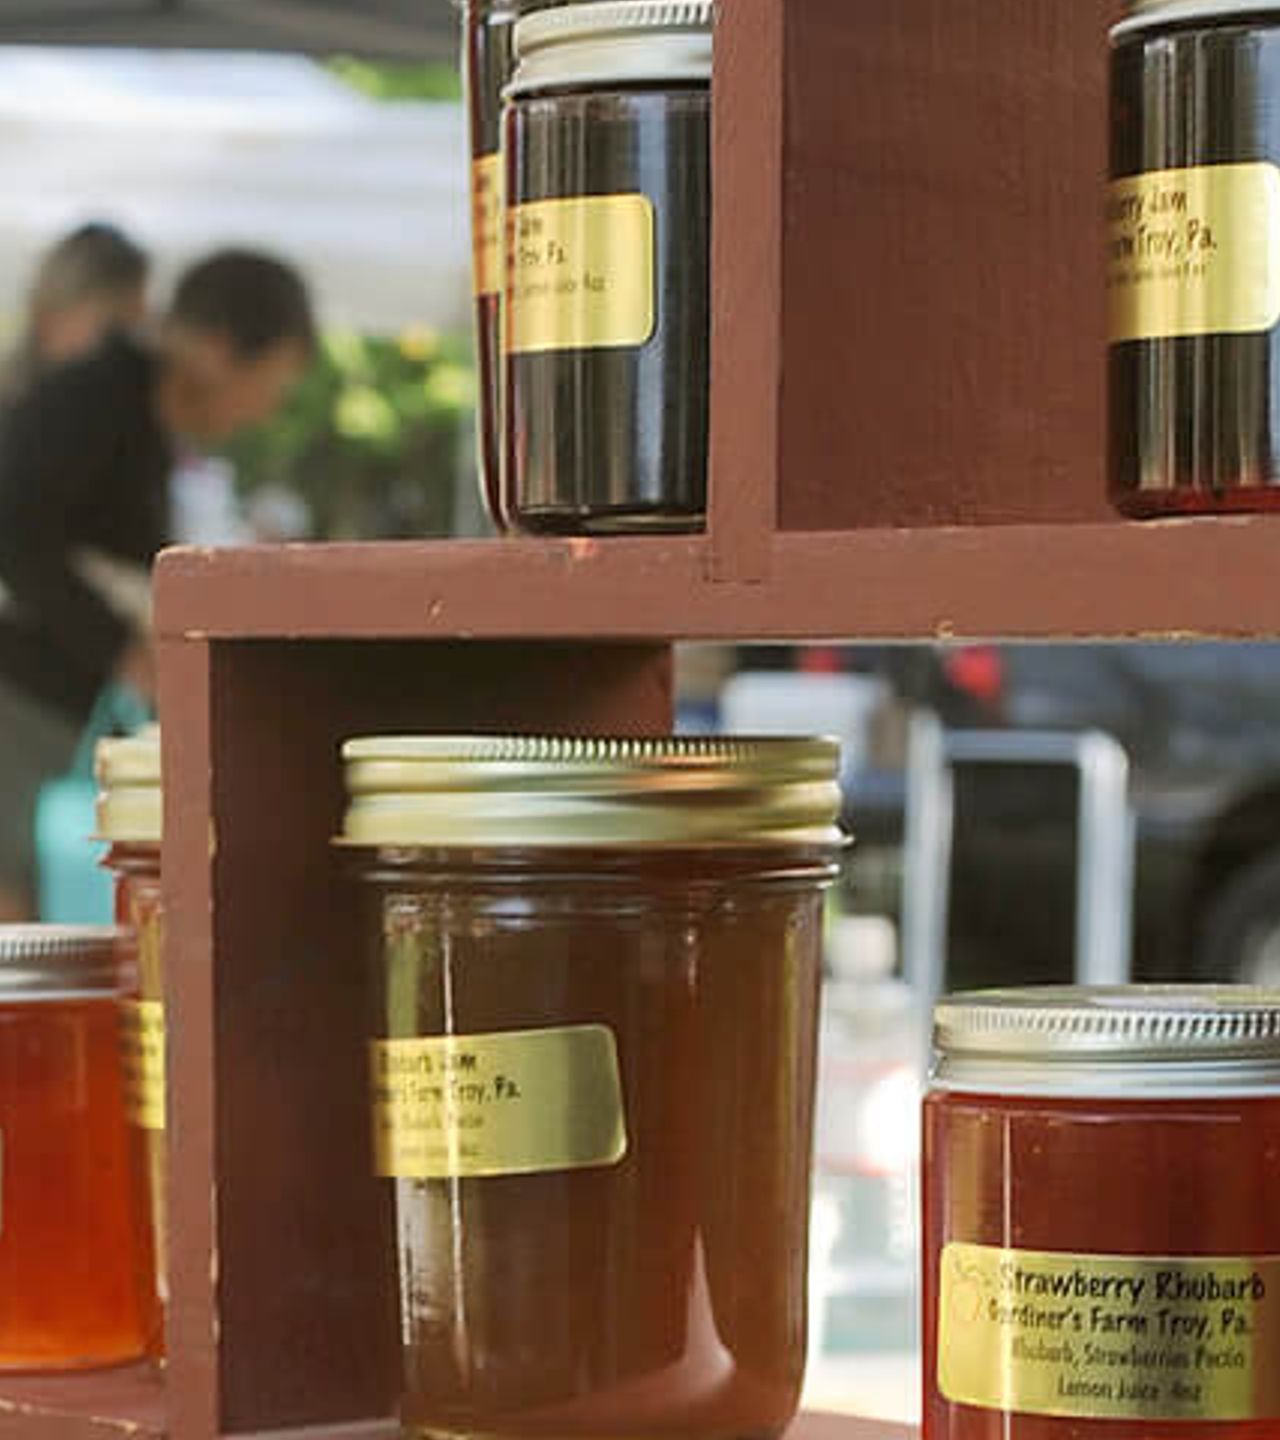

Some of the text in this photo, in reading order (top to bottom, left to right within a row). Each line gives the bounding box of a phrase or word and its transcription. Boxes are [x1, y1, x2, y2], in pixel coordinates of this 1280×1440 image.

[1000, 1262, 1266, 1305] Strawberry Rhubarb
[1090, 1305, 1147, 1334] Farm
[1158, 1308, 1213, 1340] Troy,
